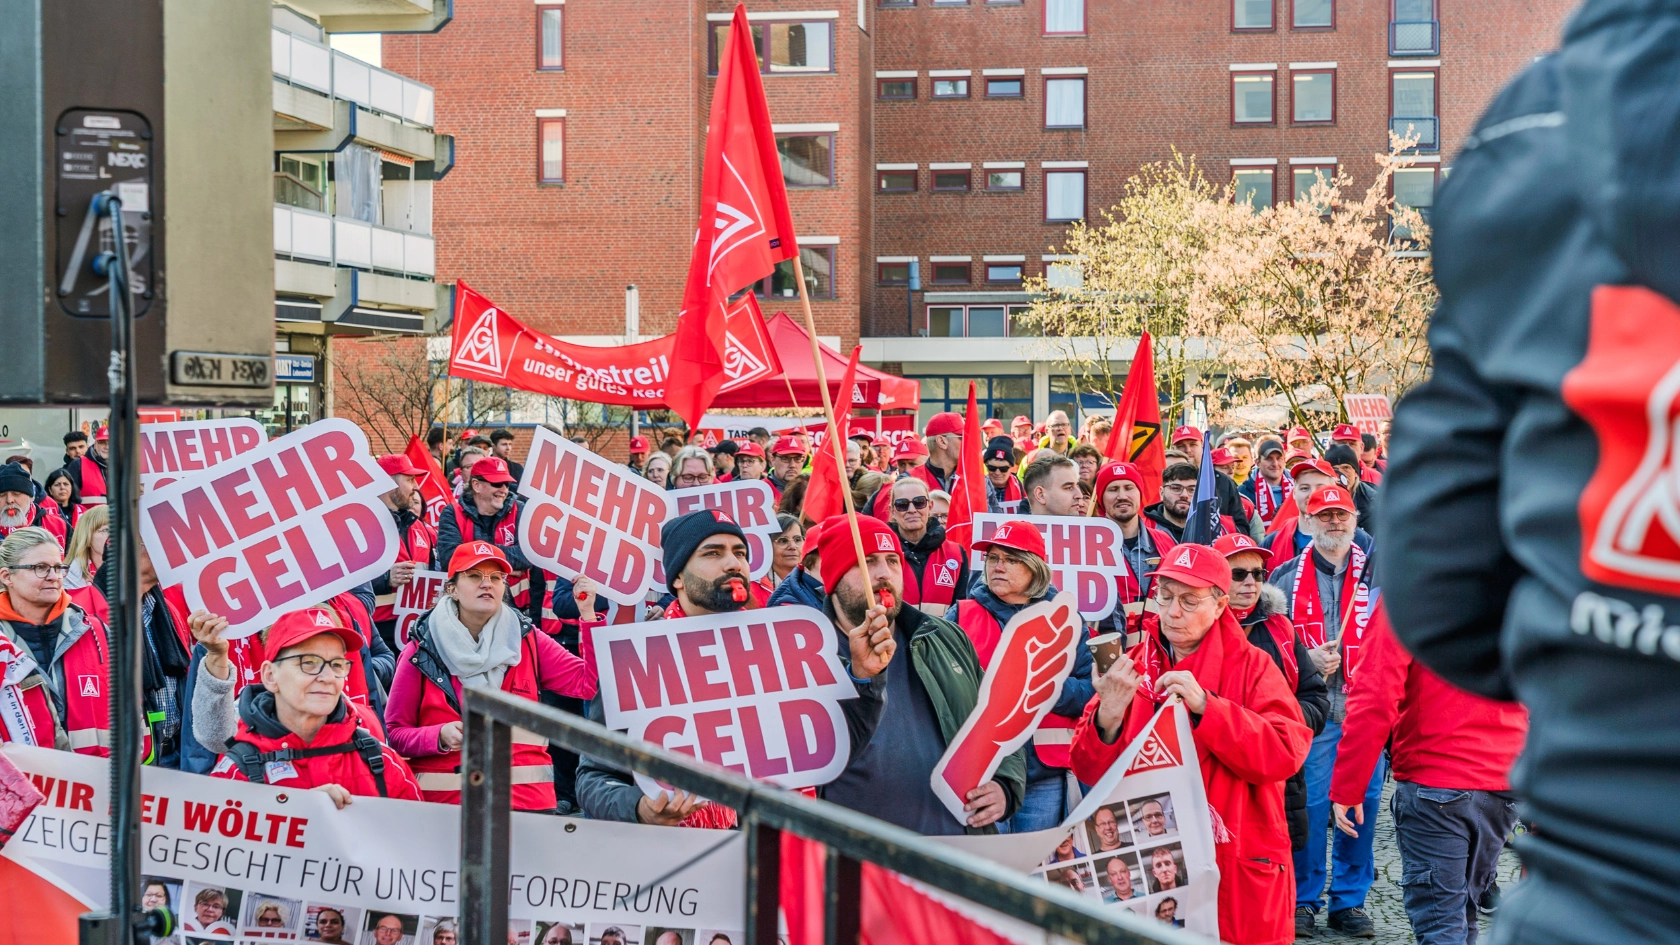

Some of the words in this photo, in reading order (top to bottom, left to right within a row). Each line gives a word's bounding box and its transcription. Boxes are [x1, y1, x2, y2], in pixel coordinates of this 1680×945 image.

[523, 358, 574, 383] unser
[1347, 397, 1394, 418] MEHR
[728, 429, 749, 438] TAR
[148, 430, 374, 569] MEHR
[530, 439, 667, 548] MEHR
[199, 503, 386, 626] GELD
[528, 502, 646, 596] GELD
[609, 619, 837, 712] MEHR
[643, 698, 836, 791] GELD
[22, 814, 111, 856] ZEIGE
[149, 834, 291, 884] GESICHT
[300, 857, 364, 896] FÜR
[375, 867, 457, 903] UNSE
[508, 874, 698, 916] FORDERUNG
[184, 799, 309, 849] WÖLTE
